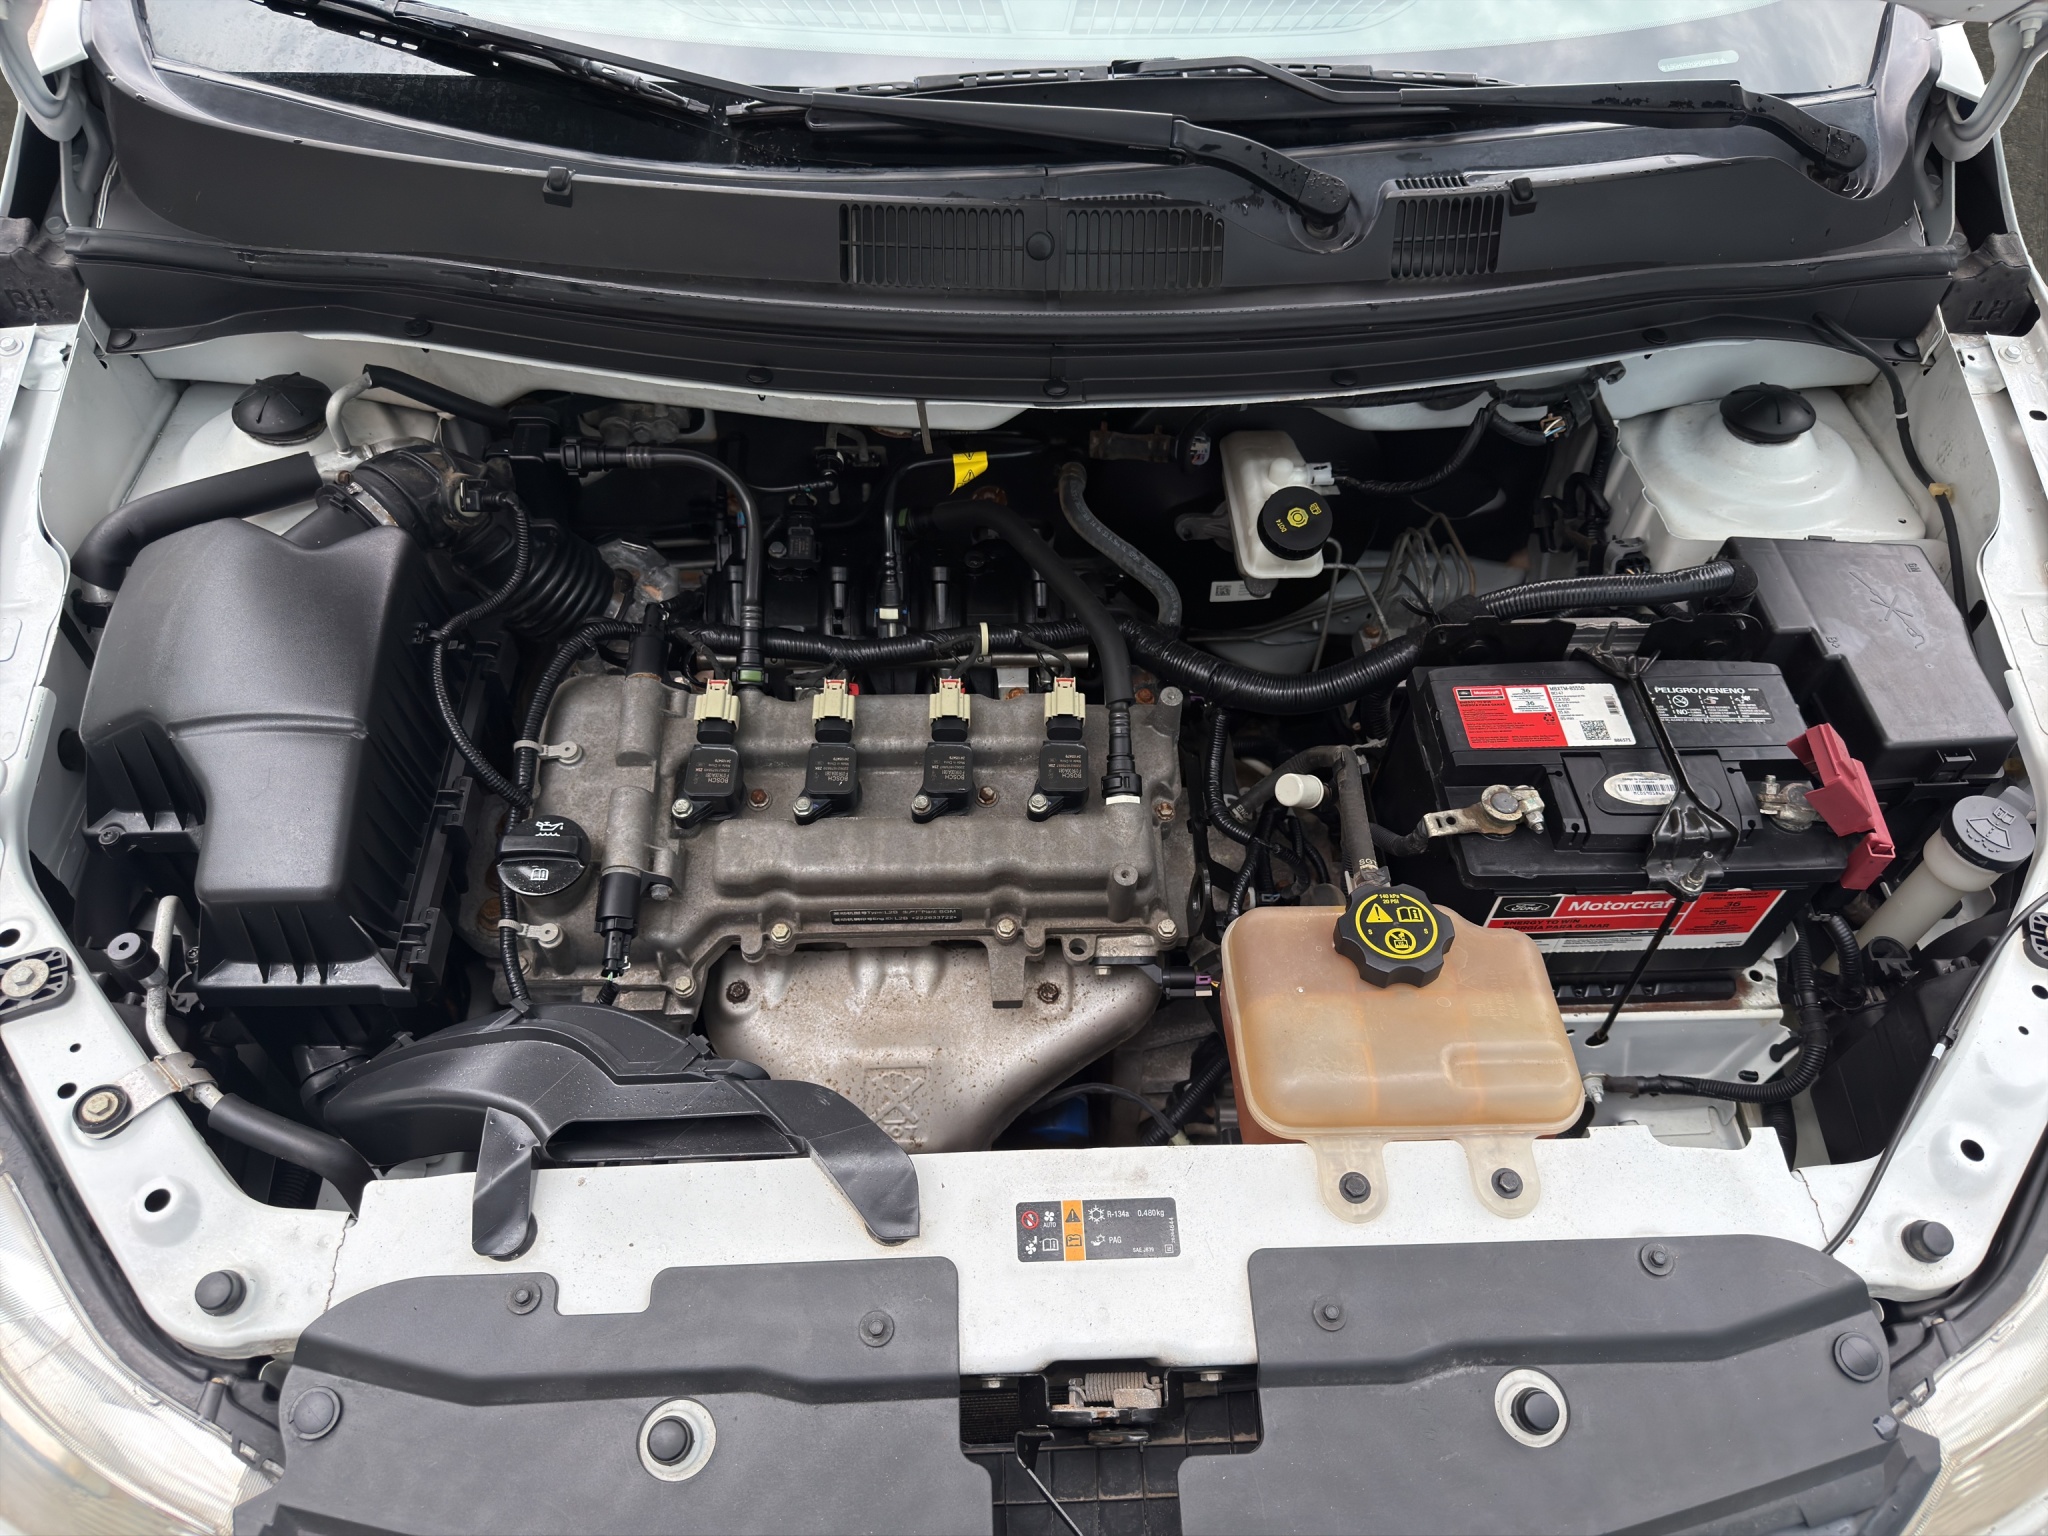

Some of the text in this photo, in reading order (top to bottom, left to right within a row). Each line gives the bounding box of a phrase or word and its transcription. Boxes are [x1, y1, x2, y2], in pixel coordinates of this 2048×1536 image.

[1967, 299, 2013, 321] LH
[1654, 686, 1746, 695] PELIGRO/VENENO
[1511, 902, 1541, 912] Ford
[1567, 898, 1676, 912] Motorcraf
[1107, 1210, 1130, 1218] R-134a
[1108, 1236, 1122, 1244] PAG
